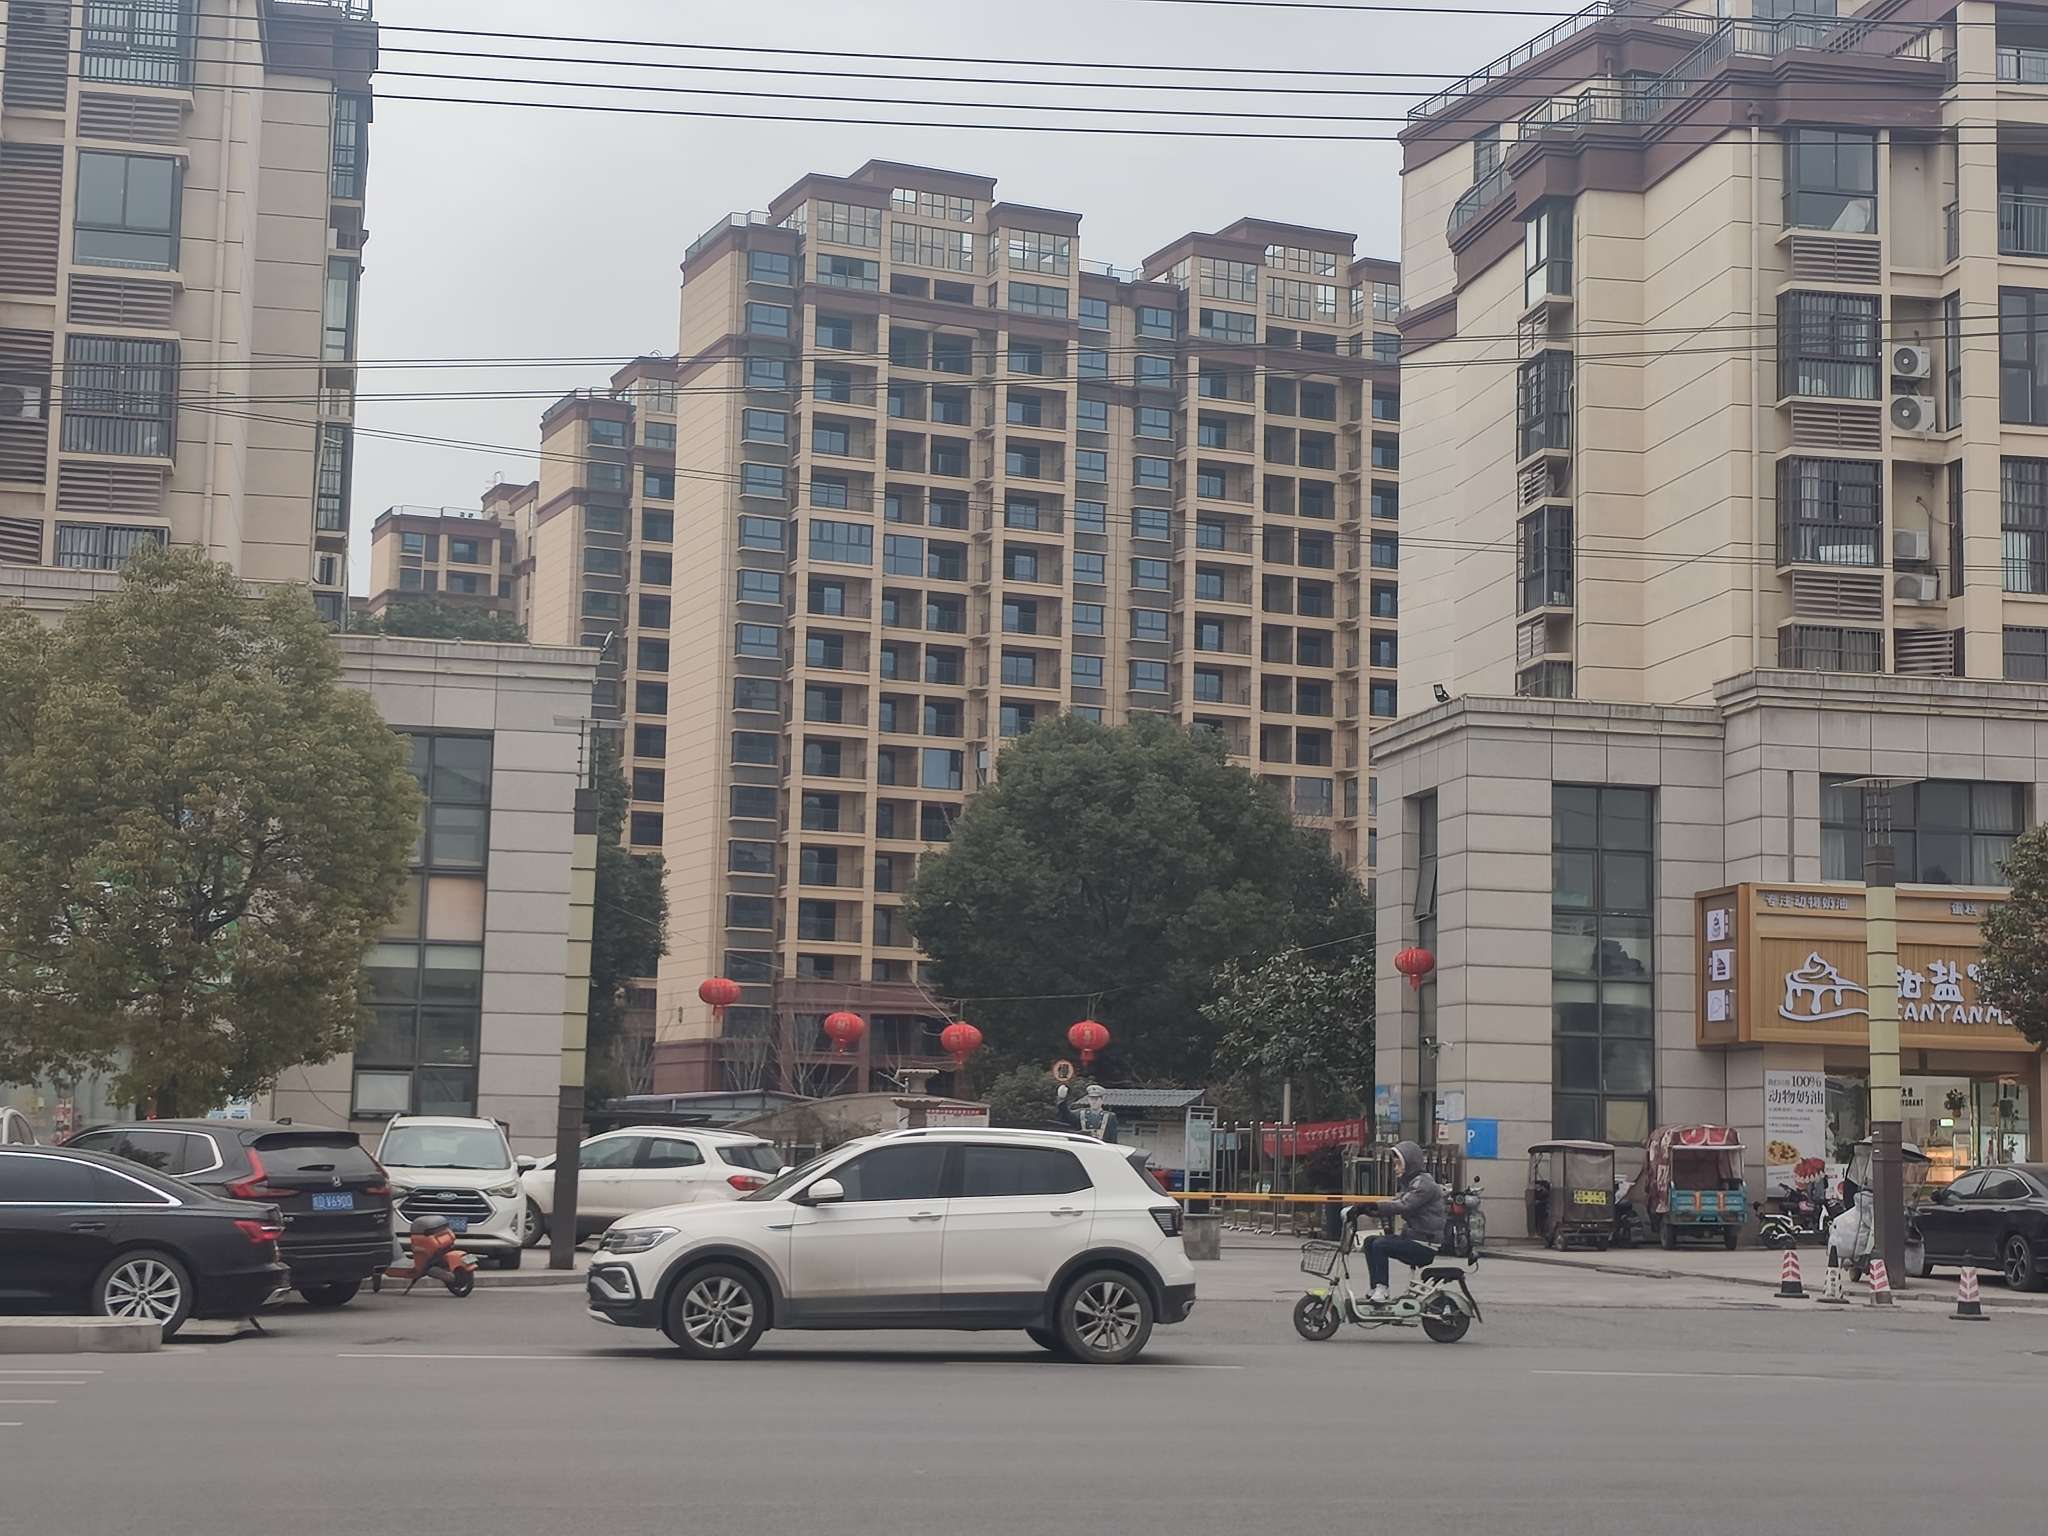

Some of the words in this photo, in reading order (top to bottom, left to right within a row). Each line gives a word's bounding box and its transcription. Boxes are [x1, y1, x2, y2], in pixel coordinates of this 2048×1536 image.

[1792, 1075, 1822, 1088] 100%
[1768, 1089, 1824, 1105] 动物奶油
[1467, 1129, 1476, 1143] P
